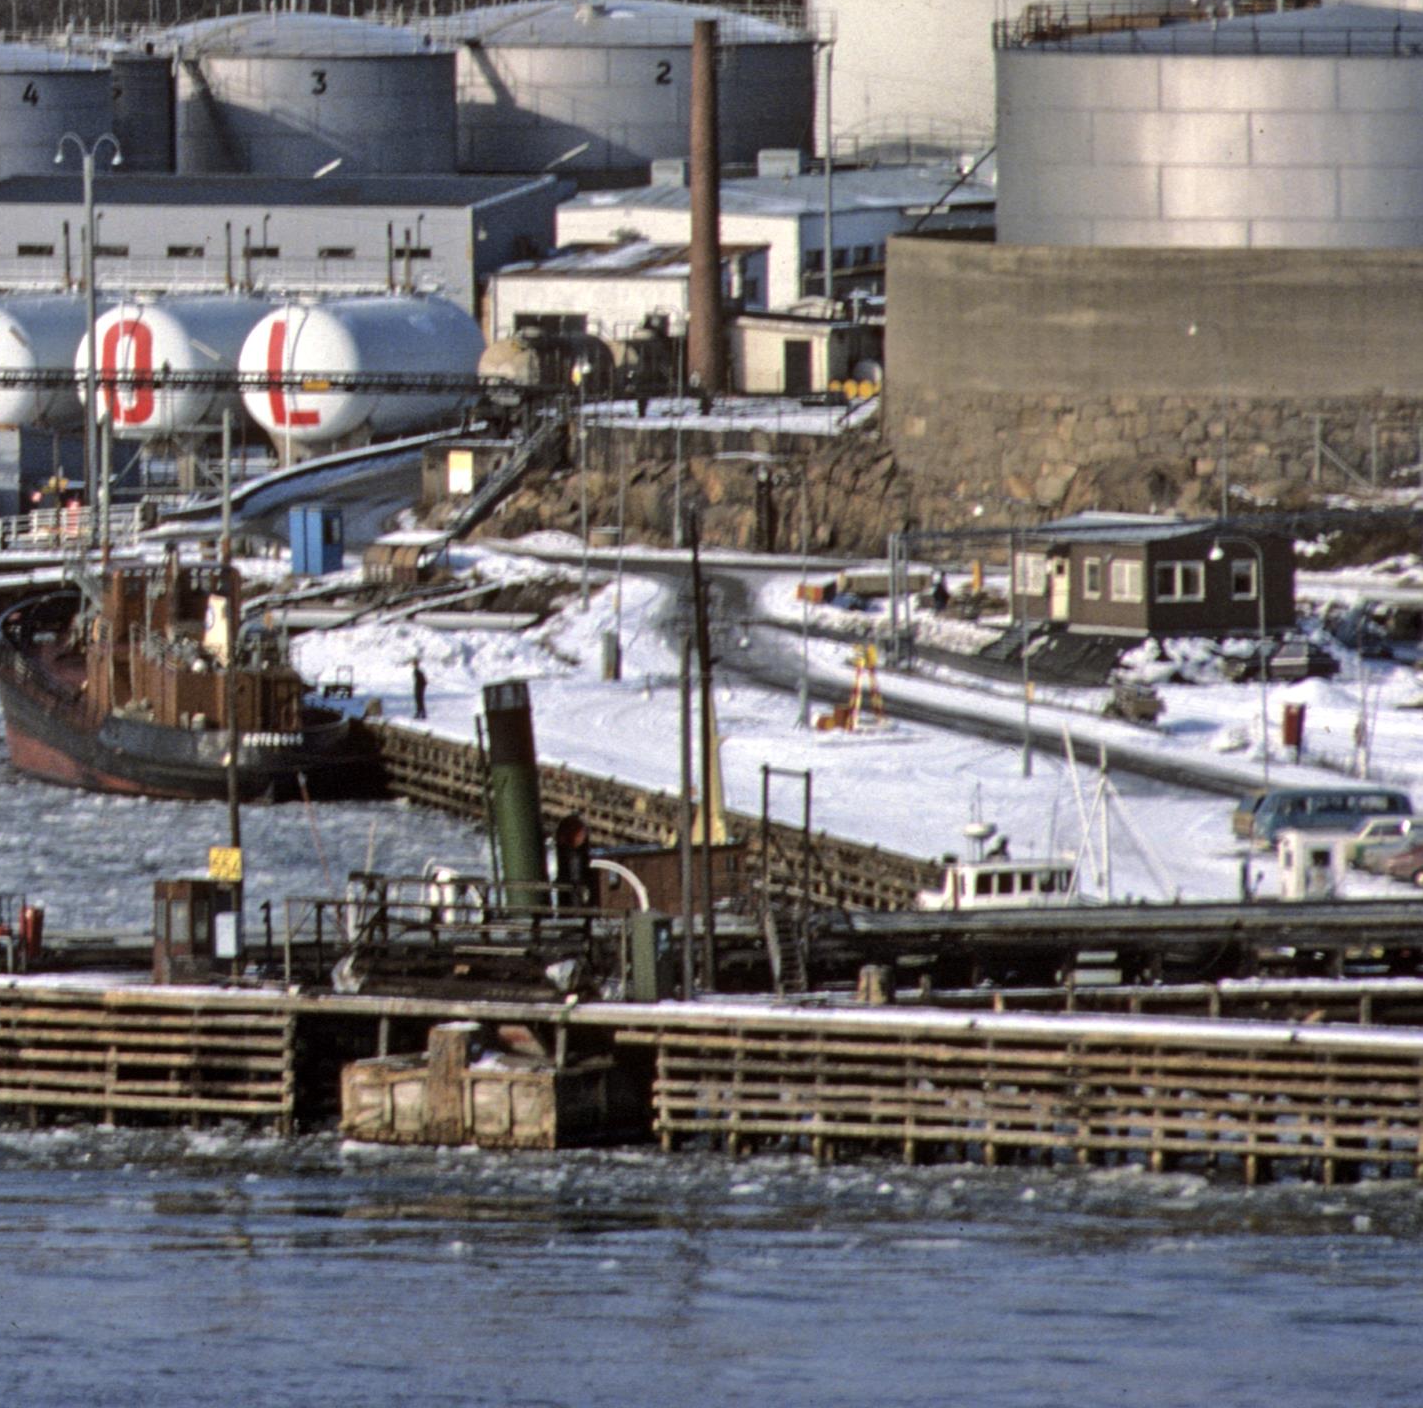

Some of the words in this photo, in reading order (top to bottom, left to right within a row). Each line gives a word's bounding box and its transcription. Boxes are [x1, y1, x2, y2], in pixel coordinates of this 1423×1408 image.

[310, 69, 328, 95] 3
[655, 60, 673, 86] 2
[22, 81, 40, 107] 4
